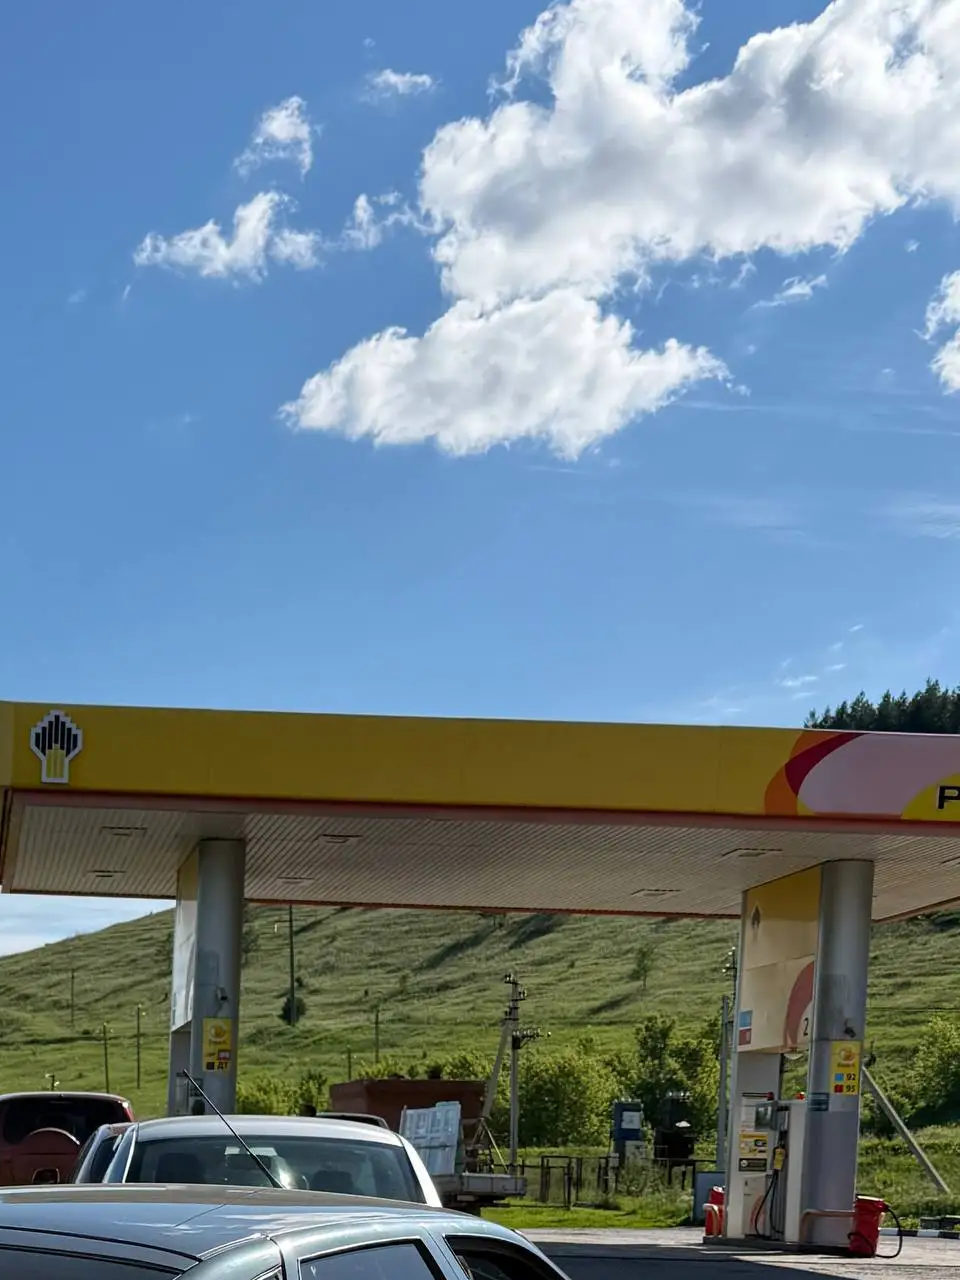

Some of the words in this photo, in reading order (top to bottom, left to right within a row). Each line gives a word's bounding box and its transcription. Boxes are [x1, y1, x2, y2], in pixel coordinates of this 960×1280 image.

[803, 1017, 809, 1036] 2
[846, 1072, 856, 1081] 92
[846, 1084, 856, 1093] 95
